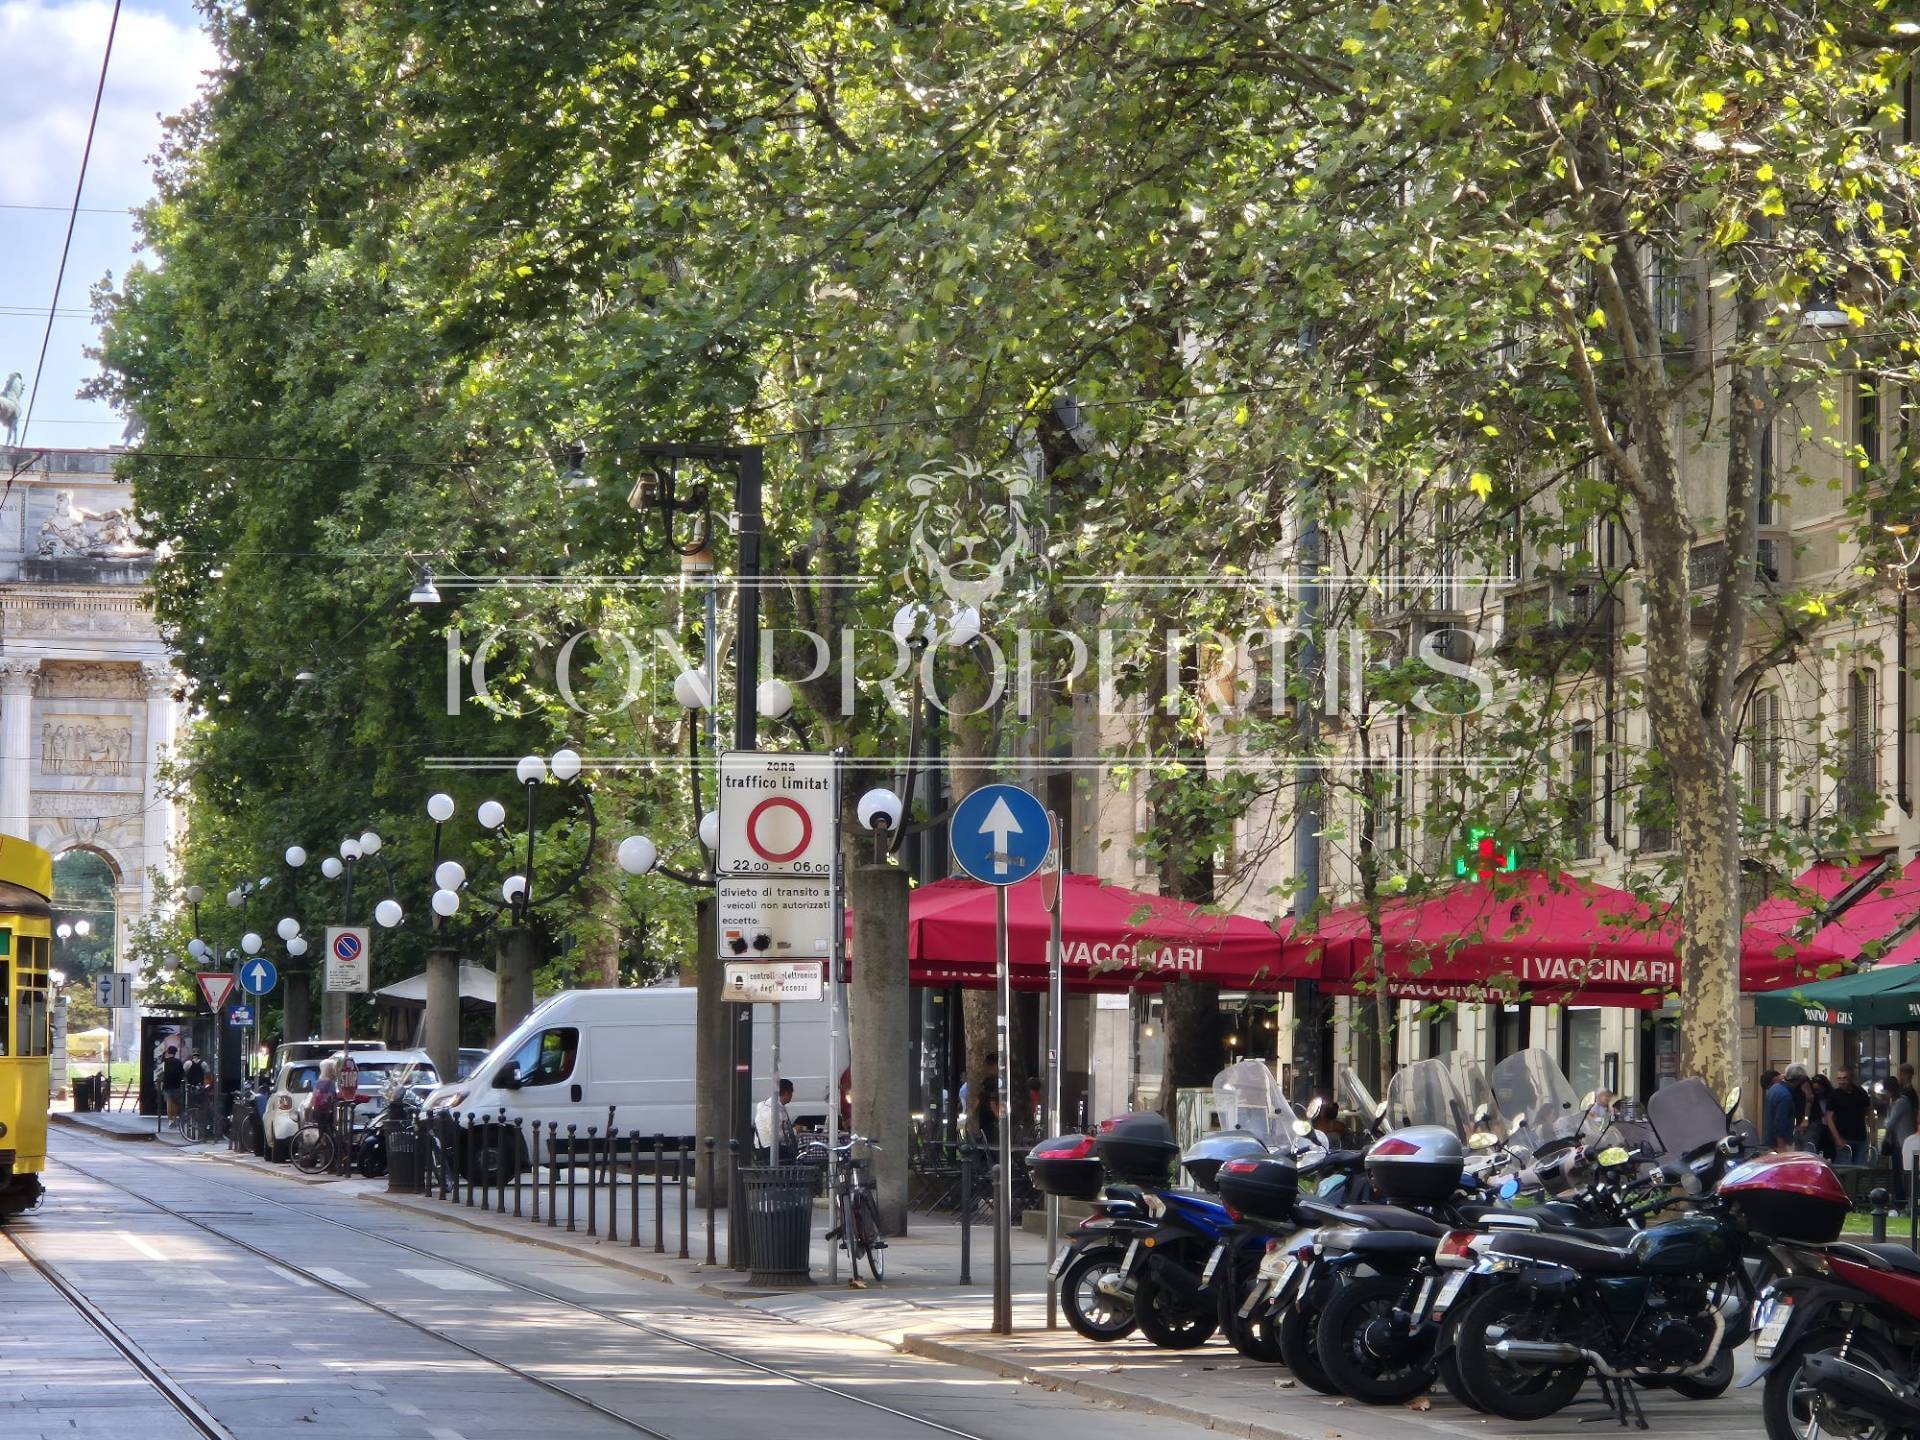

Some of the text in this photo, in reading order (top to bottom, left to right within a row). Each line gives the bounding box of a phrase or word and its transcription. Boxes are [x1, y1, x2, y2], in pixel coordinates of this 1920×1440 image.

[767, 761, 796, 772] zona
[725, 775, 830, 790] traffico limitat
[720, 887, 758, 897] divieto
[762, 887, 772, 897] di
[777, 888, 819, 897] transito
[760, 902, 779, 910] non
[782, 901, 830, 910] autorizzati
[750, 970, 778, 980] controll
[1522, 957, 1675, 984] I VACCINARI
